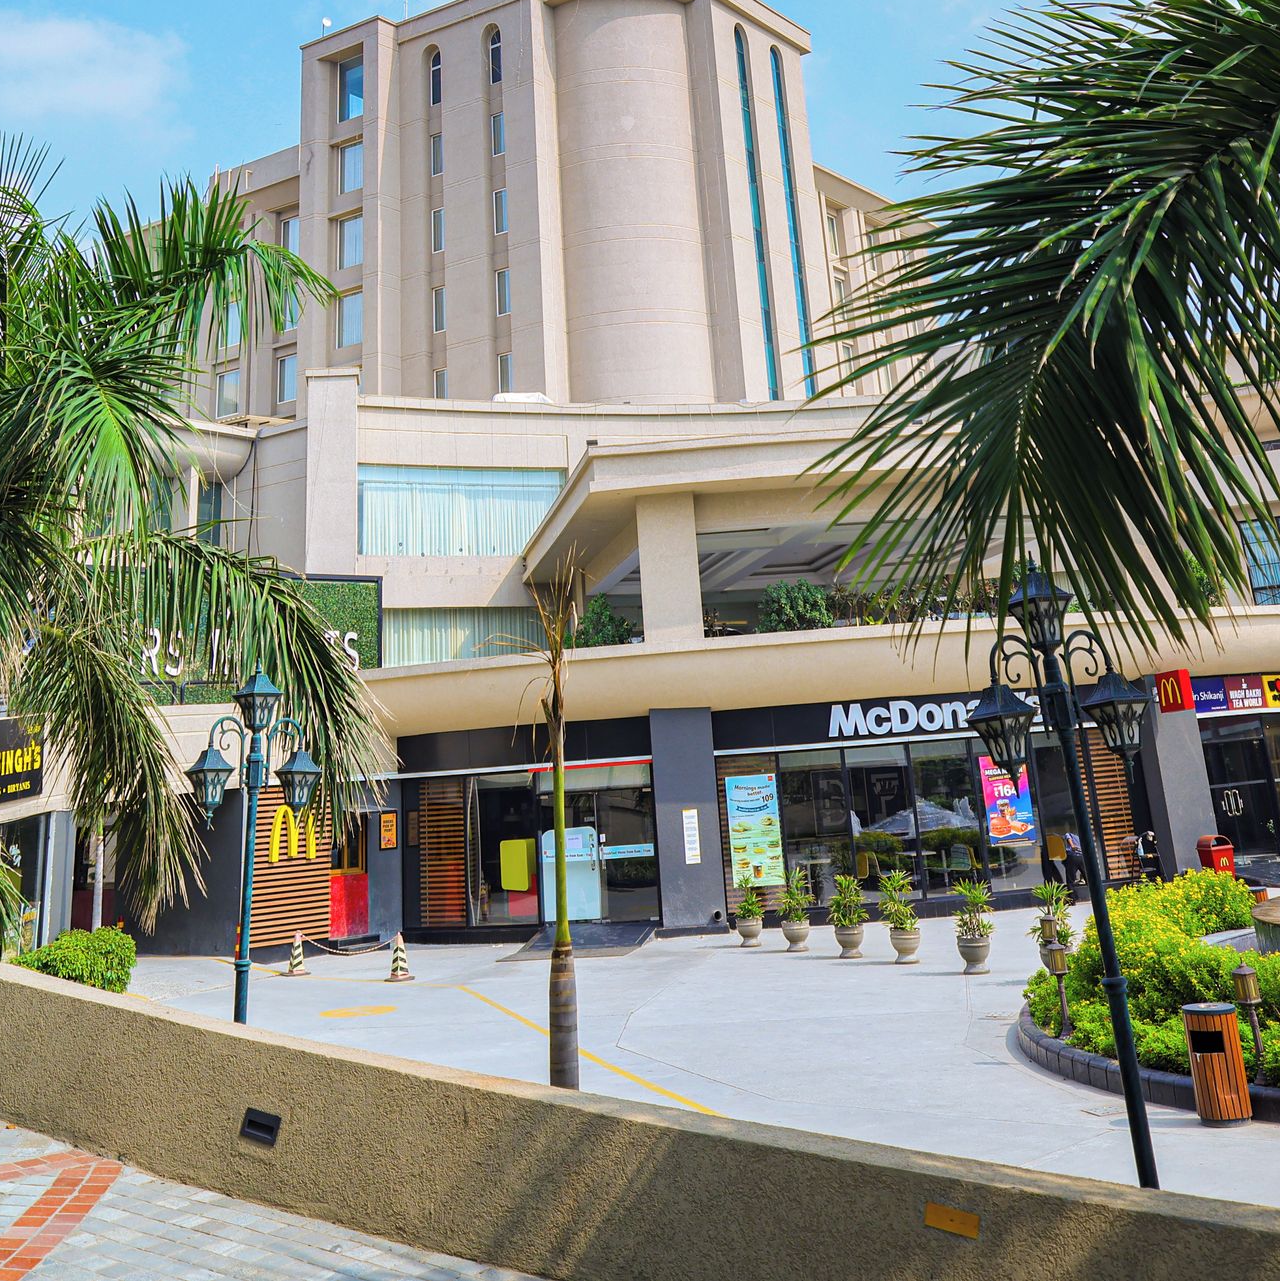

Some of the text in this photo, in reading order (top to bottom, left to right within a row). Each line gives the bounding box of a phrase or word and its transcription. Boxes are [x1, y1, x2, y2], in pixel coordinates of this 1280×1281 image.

[1199, 688, 1225, 702] Shikanji
[1229, 689, 1245, 700] WAGH
[1245, 688, 1262, 699] BAKRI
[1231, 699, 1244, 709] TEA
[1243, 697, 1263, 708] WORLD
[828, 691, 1045, 738] McDon's
[7, 781, 31, 794] BIRYANIS
